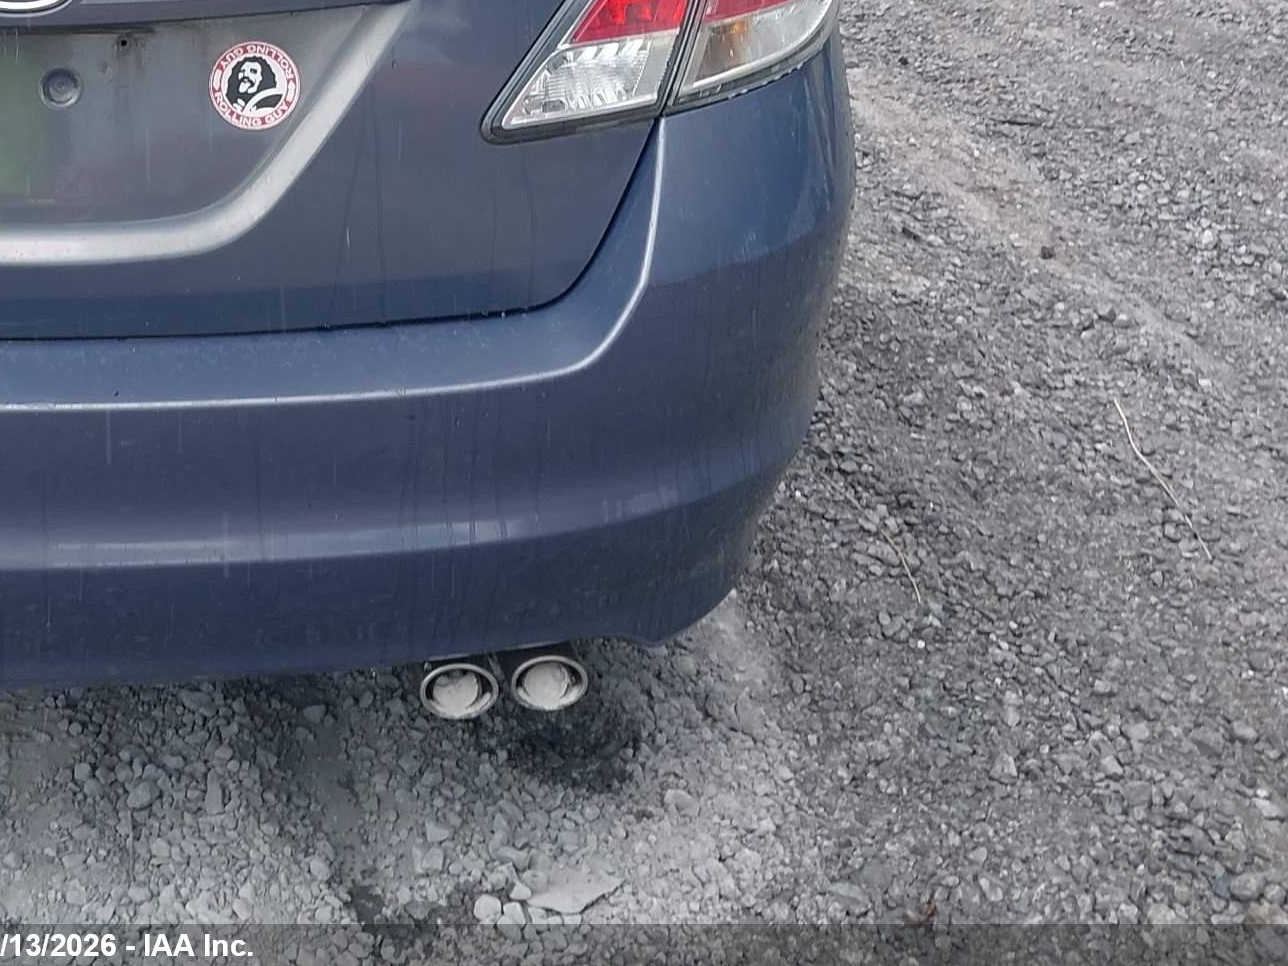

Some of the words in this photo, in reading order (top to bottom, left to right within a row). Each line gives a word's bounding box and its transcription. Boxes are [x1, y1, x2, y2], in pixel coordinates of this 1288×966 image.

[220, 47, 244, 71] GUY
[246, 44, 296, 81] ROLLING
[213, 91, 263, 127] ROLLING
[264, 101, 290, 124] GUY
